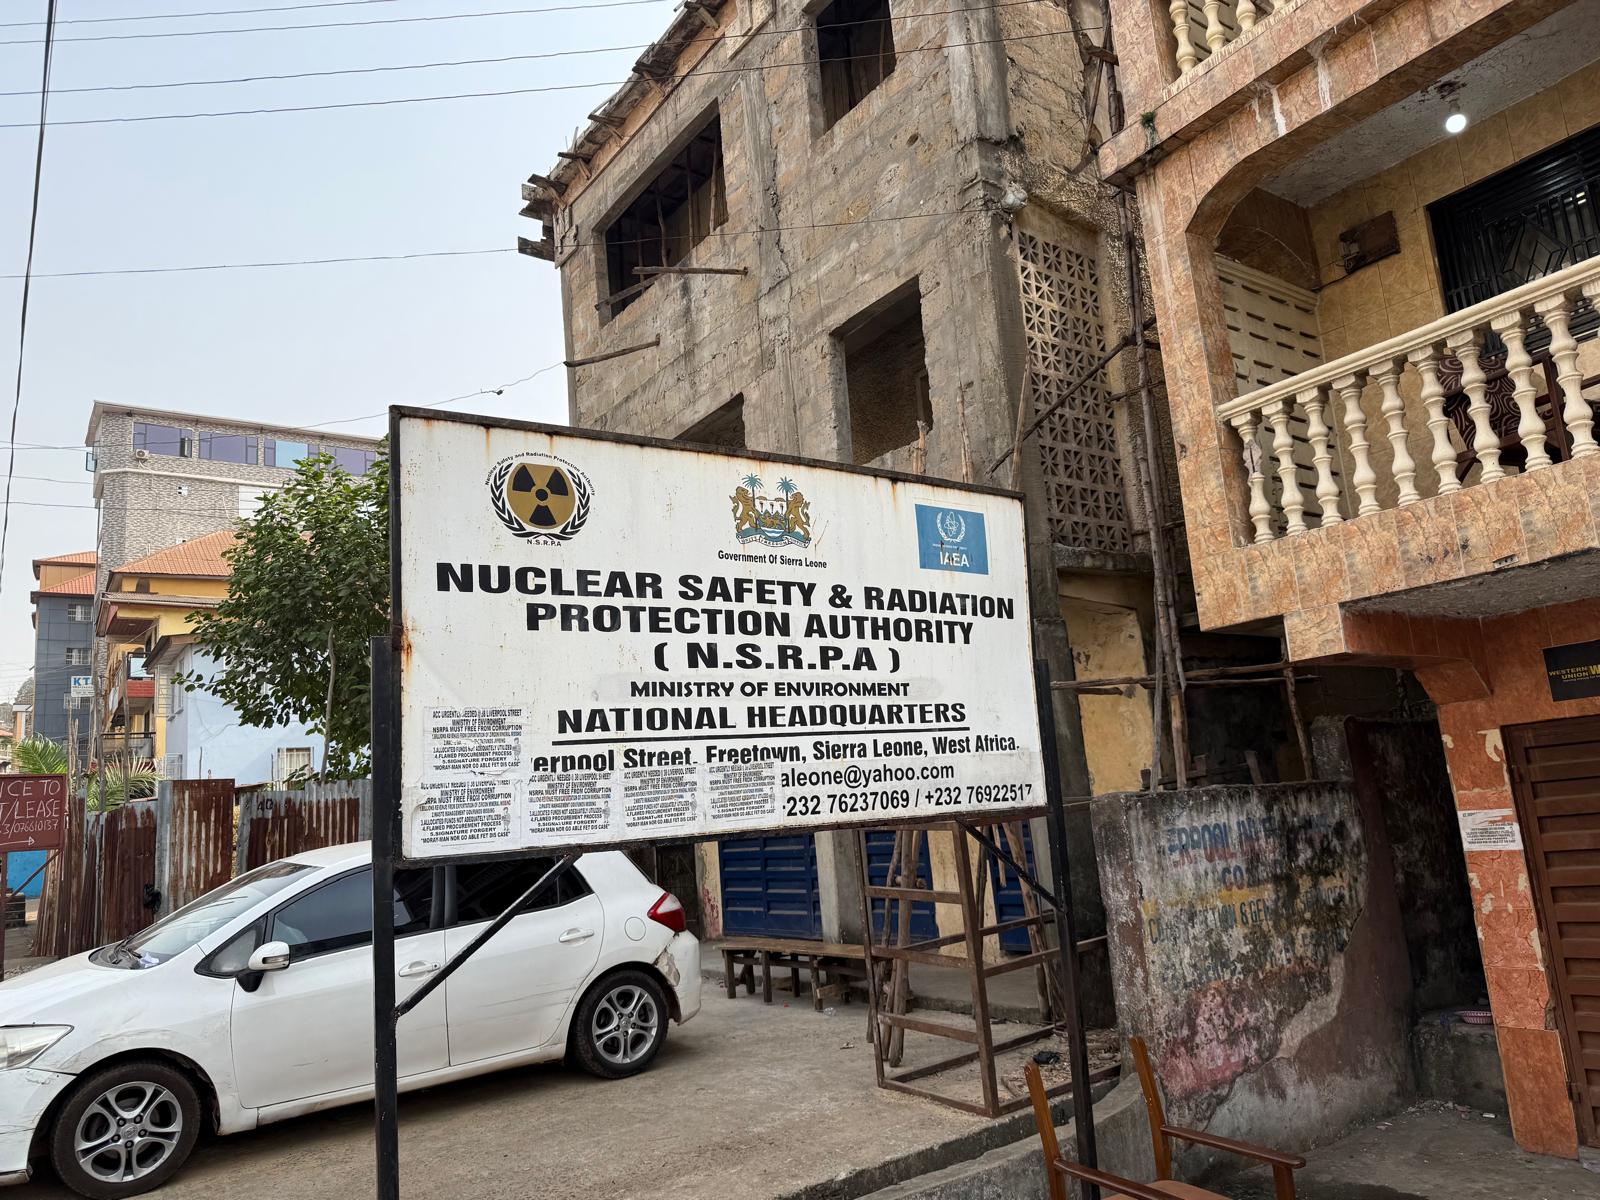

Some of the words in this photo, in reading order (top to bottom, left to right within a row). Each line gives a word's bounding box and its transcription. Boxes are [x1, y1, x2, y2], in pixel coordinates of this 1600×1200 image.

[497, 456, 514, 466] Safety
[526, 451, 552, 459] Radiation
[553, 455, 581, 473] Protection
[718, 550, 767, 564] Government
[768, 554, 778, 565] Of
[779, 555, 803, 566] Sierra
[805, 557, 827, 568] Leone
[939, 551, 970, 568] IAEA
[437, 562, 662, 599] NUCLEAR
[678, 574, 817, 607] SAFETY
[828, 584, 853, 609] &
[864, 586, 1014, 620] RADIATION
[526, 602, 790, 638] PROTECTION
[803, 613, 974, 645] AUTHORITY
[687, 642, 878, 672] N.S.R.P.A
[1549, 666, 1588, 677] WESTERN
[1589, 664, 1600, 675] W
[1561, 671, 1589, 680] UNION
[630, 681, 735, 698] MINISTRY
[739, 681, 768, 697] OF
[775, 681, 910, 698] ENVIRONMENT
[557, 706, 737, 734] NATIONAL
[746, 702, 966, 729] HEADQUARTERS
[531, 749, 615, 773] erpool
[705, 745, 807, 765] Freetown,
[812, 740, 867, 761] Sierra
[872, 738, 928, 759] Leone,
[932, 736, 971, 755] West
[975, 734, 1020, 753] Africa.
[781, 764, 954, 789] aleone@yahoo.com
[39, 779, 61, 796] TO
[481, 793, 512, 801] CORRUPTION
[783, 794, 821, 817] 232
[827, 788, 910, 815] 76237069
[924, 786, 962, 806] +232
[966, 783, 1033, 804] 76922517
[0, 818, 60, 839] 3/076610137
[446, 822, 480, 830] PROCUREMENT
